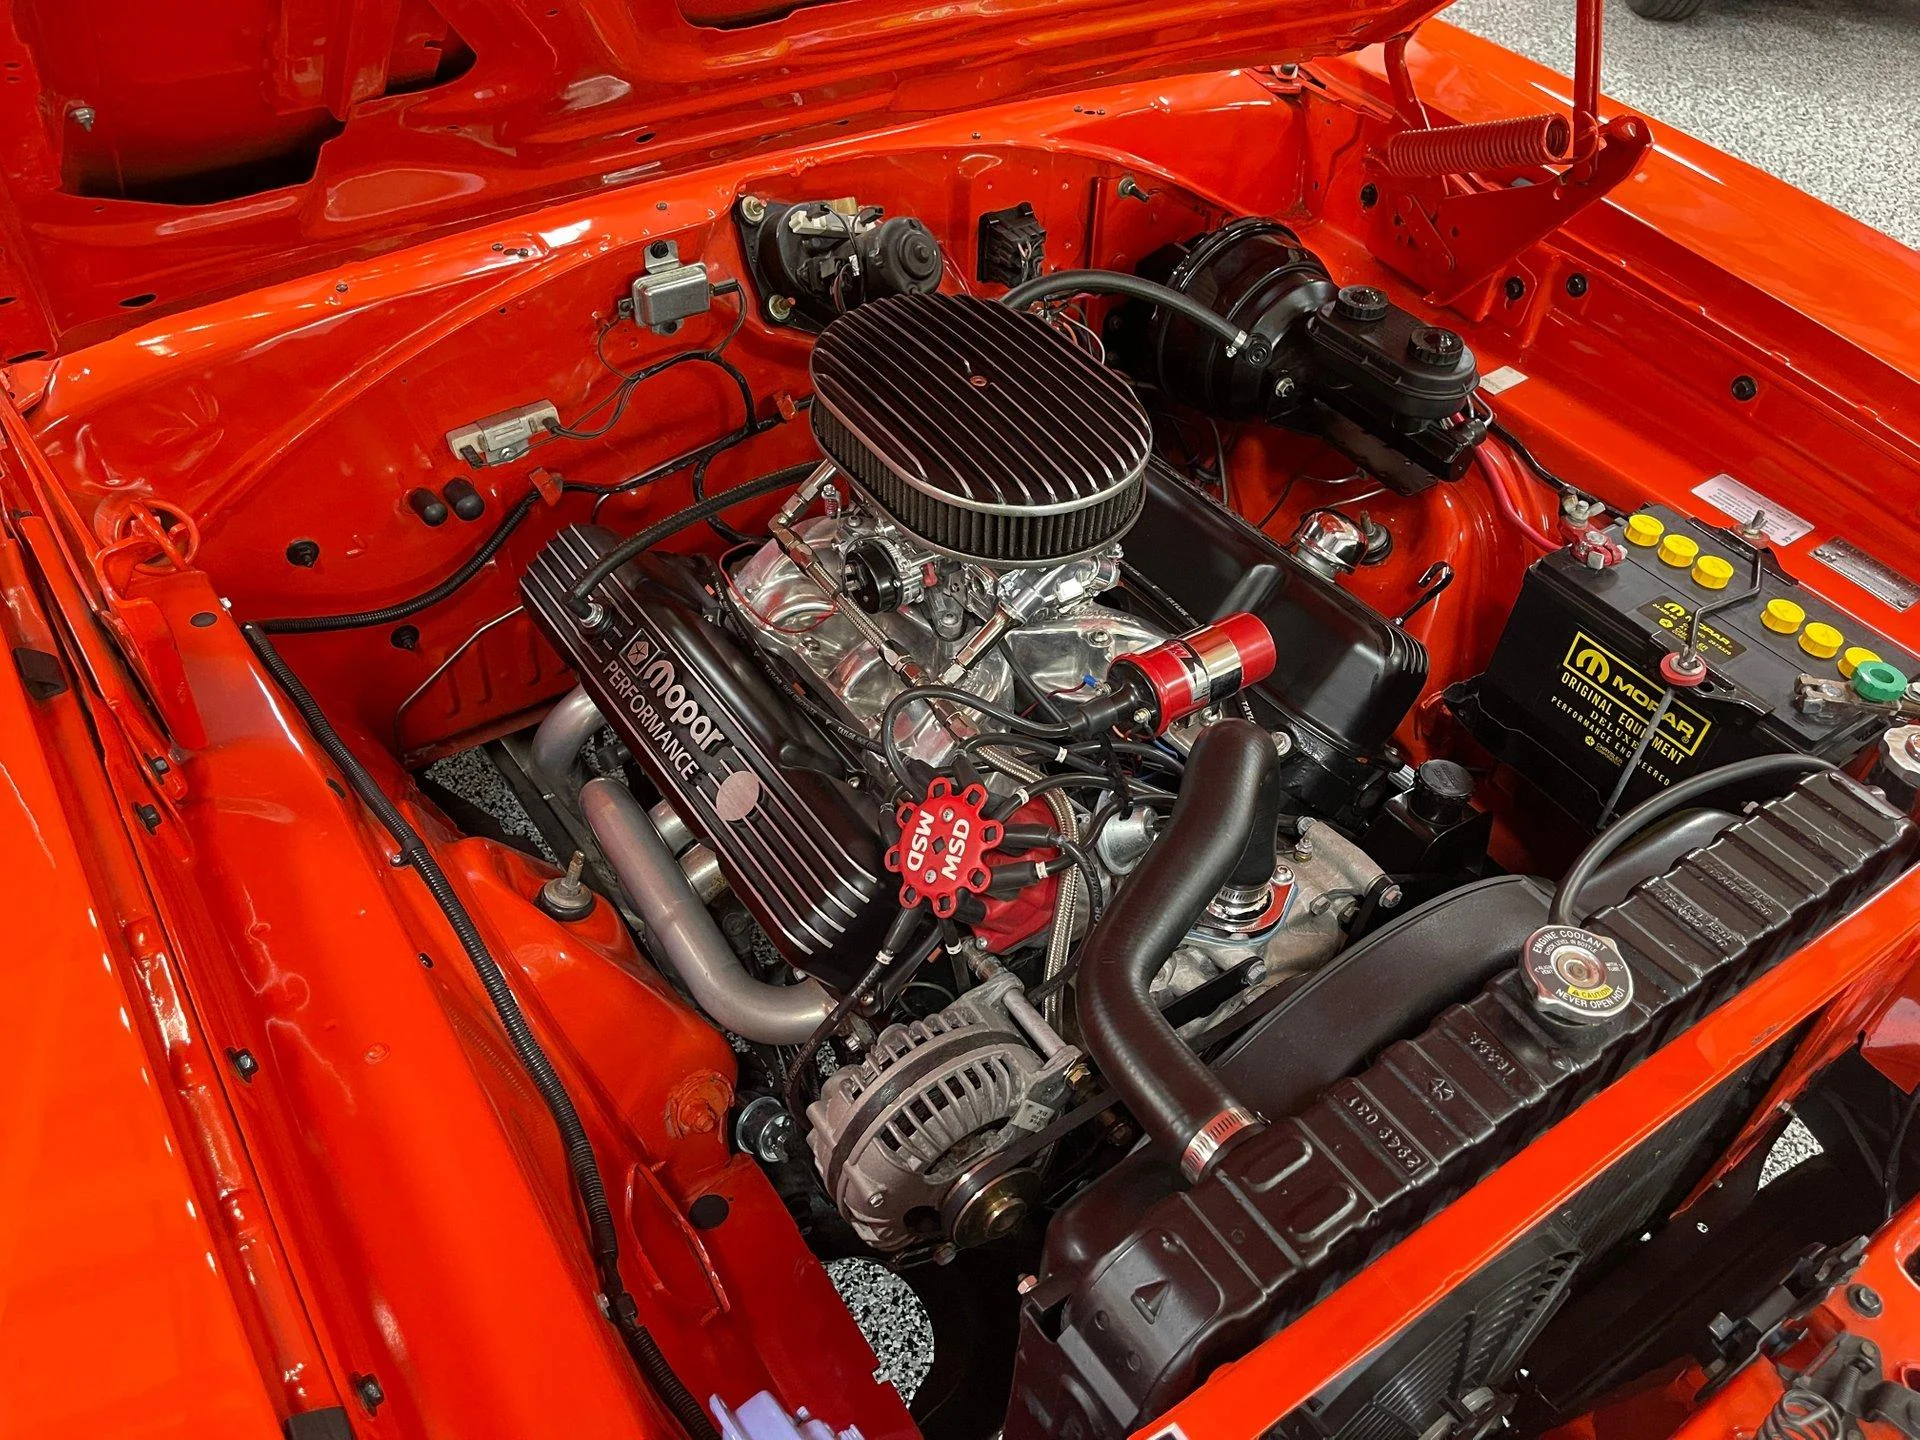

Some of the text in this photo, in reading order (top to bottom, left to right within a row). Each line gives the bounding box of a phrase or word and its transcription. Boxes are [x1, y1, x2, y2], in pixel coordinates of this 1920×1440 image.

[602, 660, 700, 781] PERFORMANCE
[837, 726, 856, 741] TAYLOR
[1560, 671, 1686, 765] ORIGINAL EQUIMENT
[1589, 710, 1640, 750] DELUXE
[1551, 695, 1671, 786] PERFORMANCE ENGNEERED
[906, 809, 935, 872] MSD
[941, 818, 970, 881] MSD
[1532, 930, 1608, 954] ENGINE COOLANT
[1577, 940, 1598, 954] BOTTLE
[1555, 985, 1627, 1009] NEVER OPEN HOT
[1581, 987, 1611, 999] CAUTION
